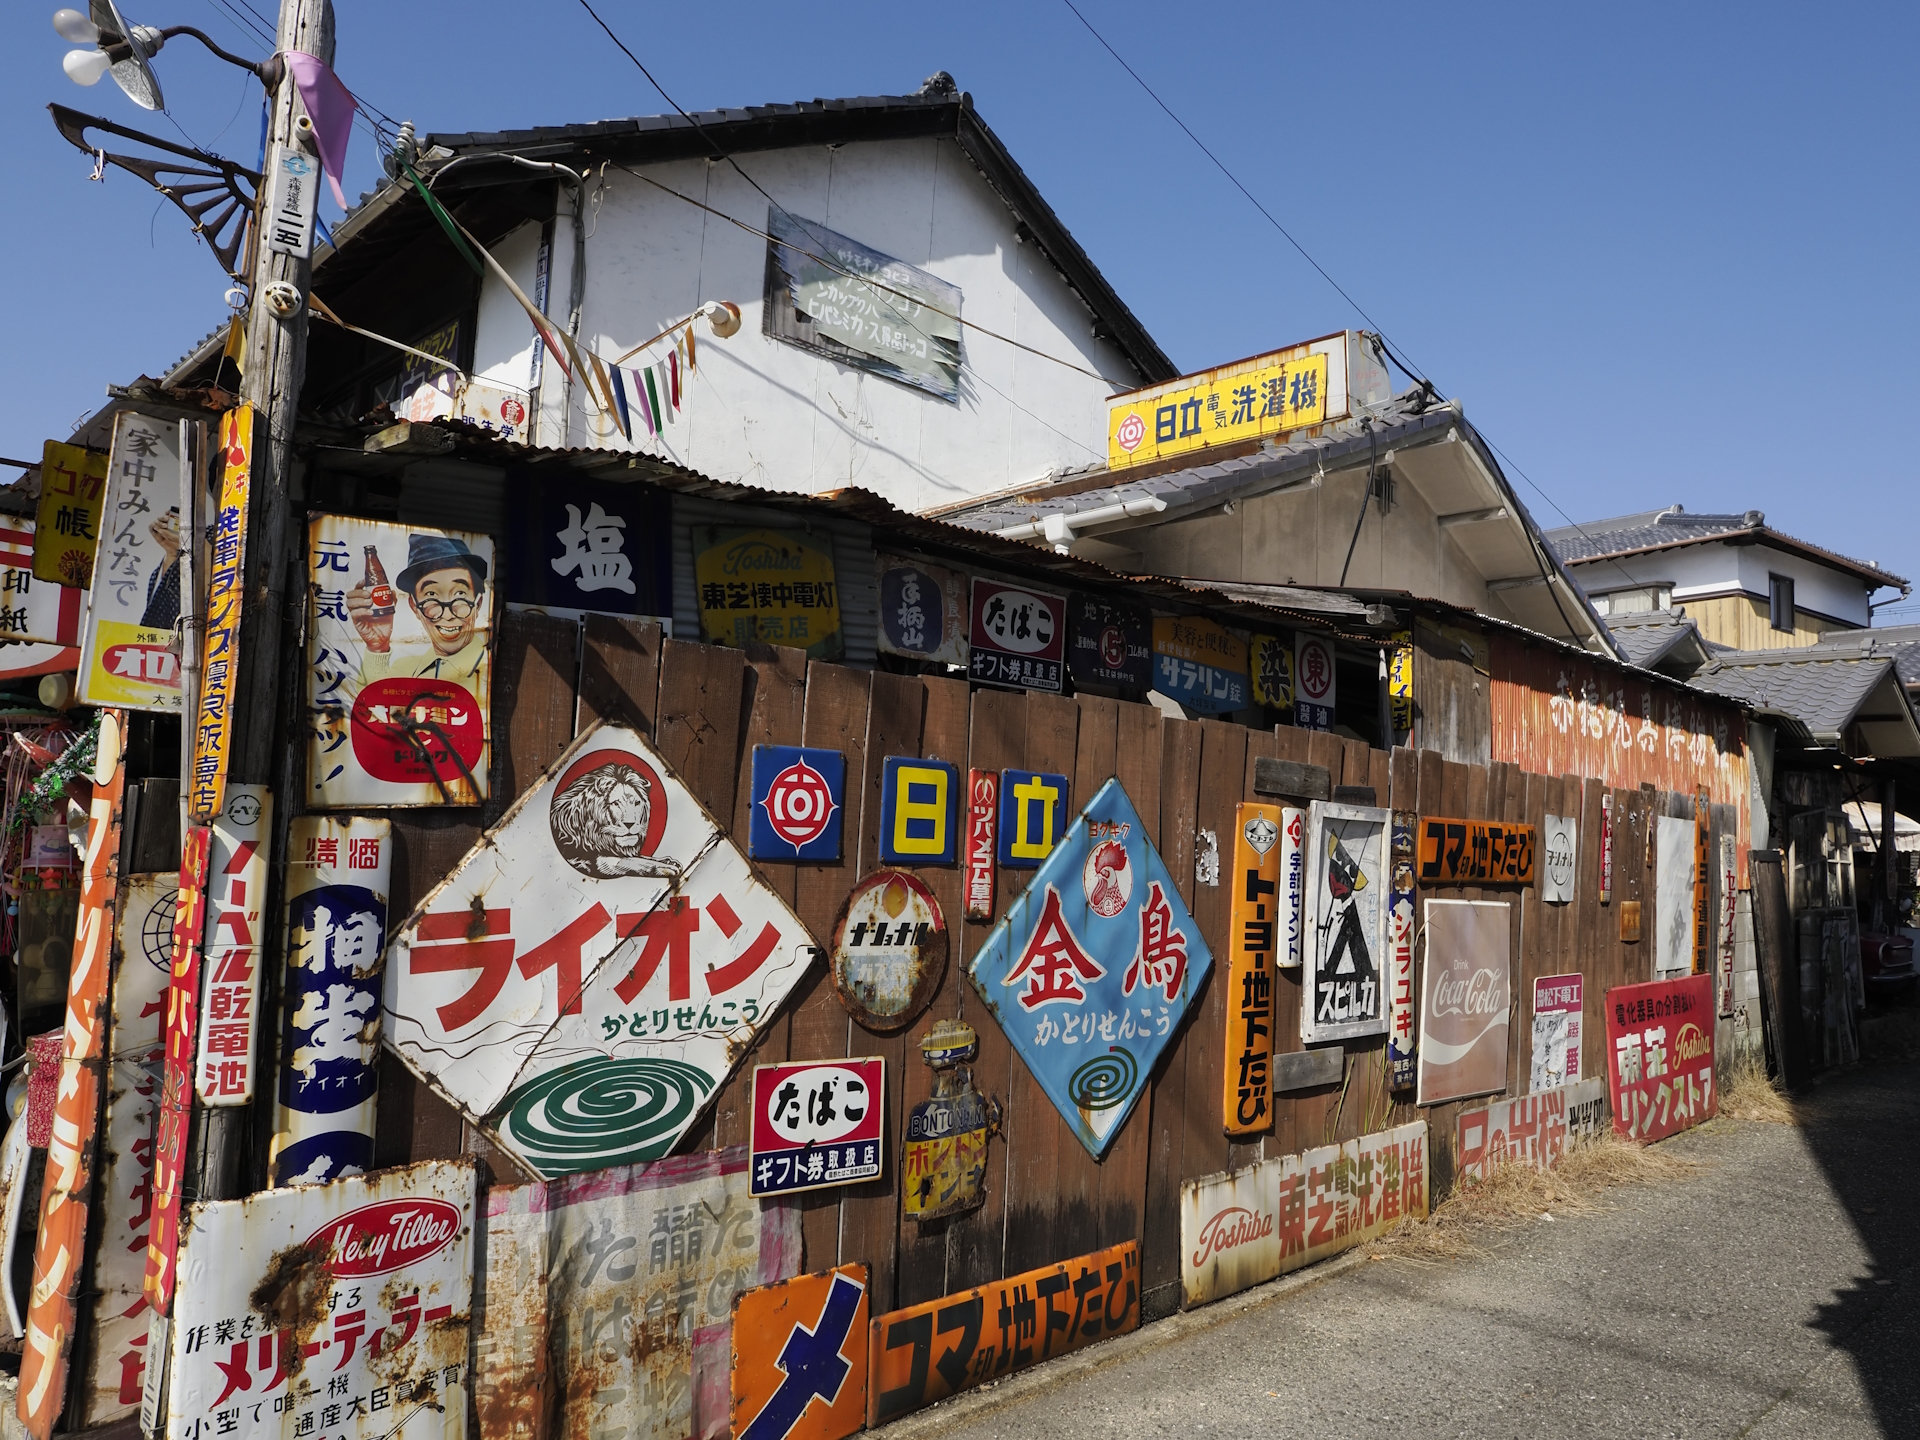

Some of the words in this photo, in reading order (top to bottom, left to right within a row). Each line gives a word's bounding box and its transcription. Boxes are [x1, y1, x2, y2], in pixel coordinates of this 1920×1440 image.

[108, 427, 161, 607] 家中みんなで
[550, 501, 637, 595] 塩
[722, 540, 804, 575] Toshiba
[702, 581, 834, 609] 東芝懐中電灯
[733, 615, 809, 642] 販売店
[985, 597, 1051, 644] たばこ
[1170, 621, 1237, 658] 美容と便秘に
[1258, 638, 1291, 703] 染
[1304, 647, 1327, 692] 東
[394, 749, 449, 764] ドリク
[893, 765, 948, 855] 日
[1010, 776, 1060, 860] 立
[305, 836, 381, 870] 清酒
[203, 840, 261, 1097] ノーベル乾電池
[409, 892, 783, 1033] ライオン
[1001, 880, 1188, 1012] 金鳥
[1453, 959, 1469, 970] Drink
[167, 885, 199, 1059] オリバー
[1394, 913, 1413, 1039] シラユキ
[601, 998, 760, 1042] かとりせんこう
[1236, 868, 1275, 1128] トーヨー地下たび
[1615, 991, 1697, 1027] 電化器具の分割払い
[1035, 1006, 1171, 1047] かとりせんこう
[1672, 1022, 1712, 1071] Toshiba
[1616, 1025, 1668, 1087] 東芝
[296, 1071, 366, 1094] アイオイ
[773, 1075, 865, 1129] たばこ
[1619, 1066, 1712, 1139] リンクストア
[756, 1152, 825, 1190] ギフト券
[828, 1144, 875, 1170] 取扱店
[389, 1208, 452, 1254] Tiller
[1192, 1206, 1273, 1268] Toshiba
